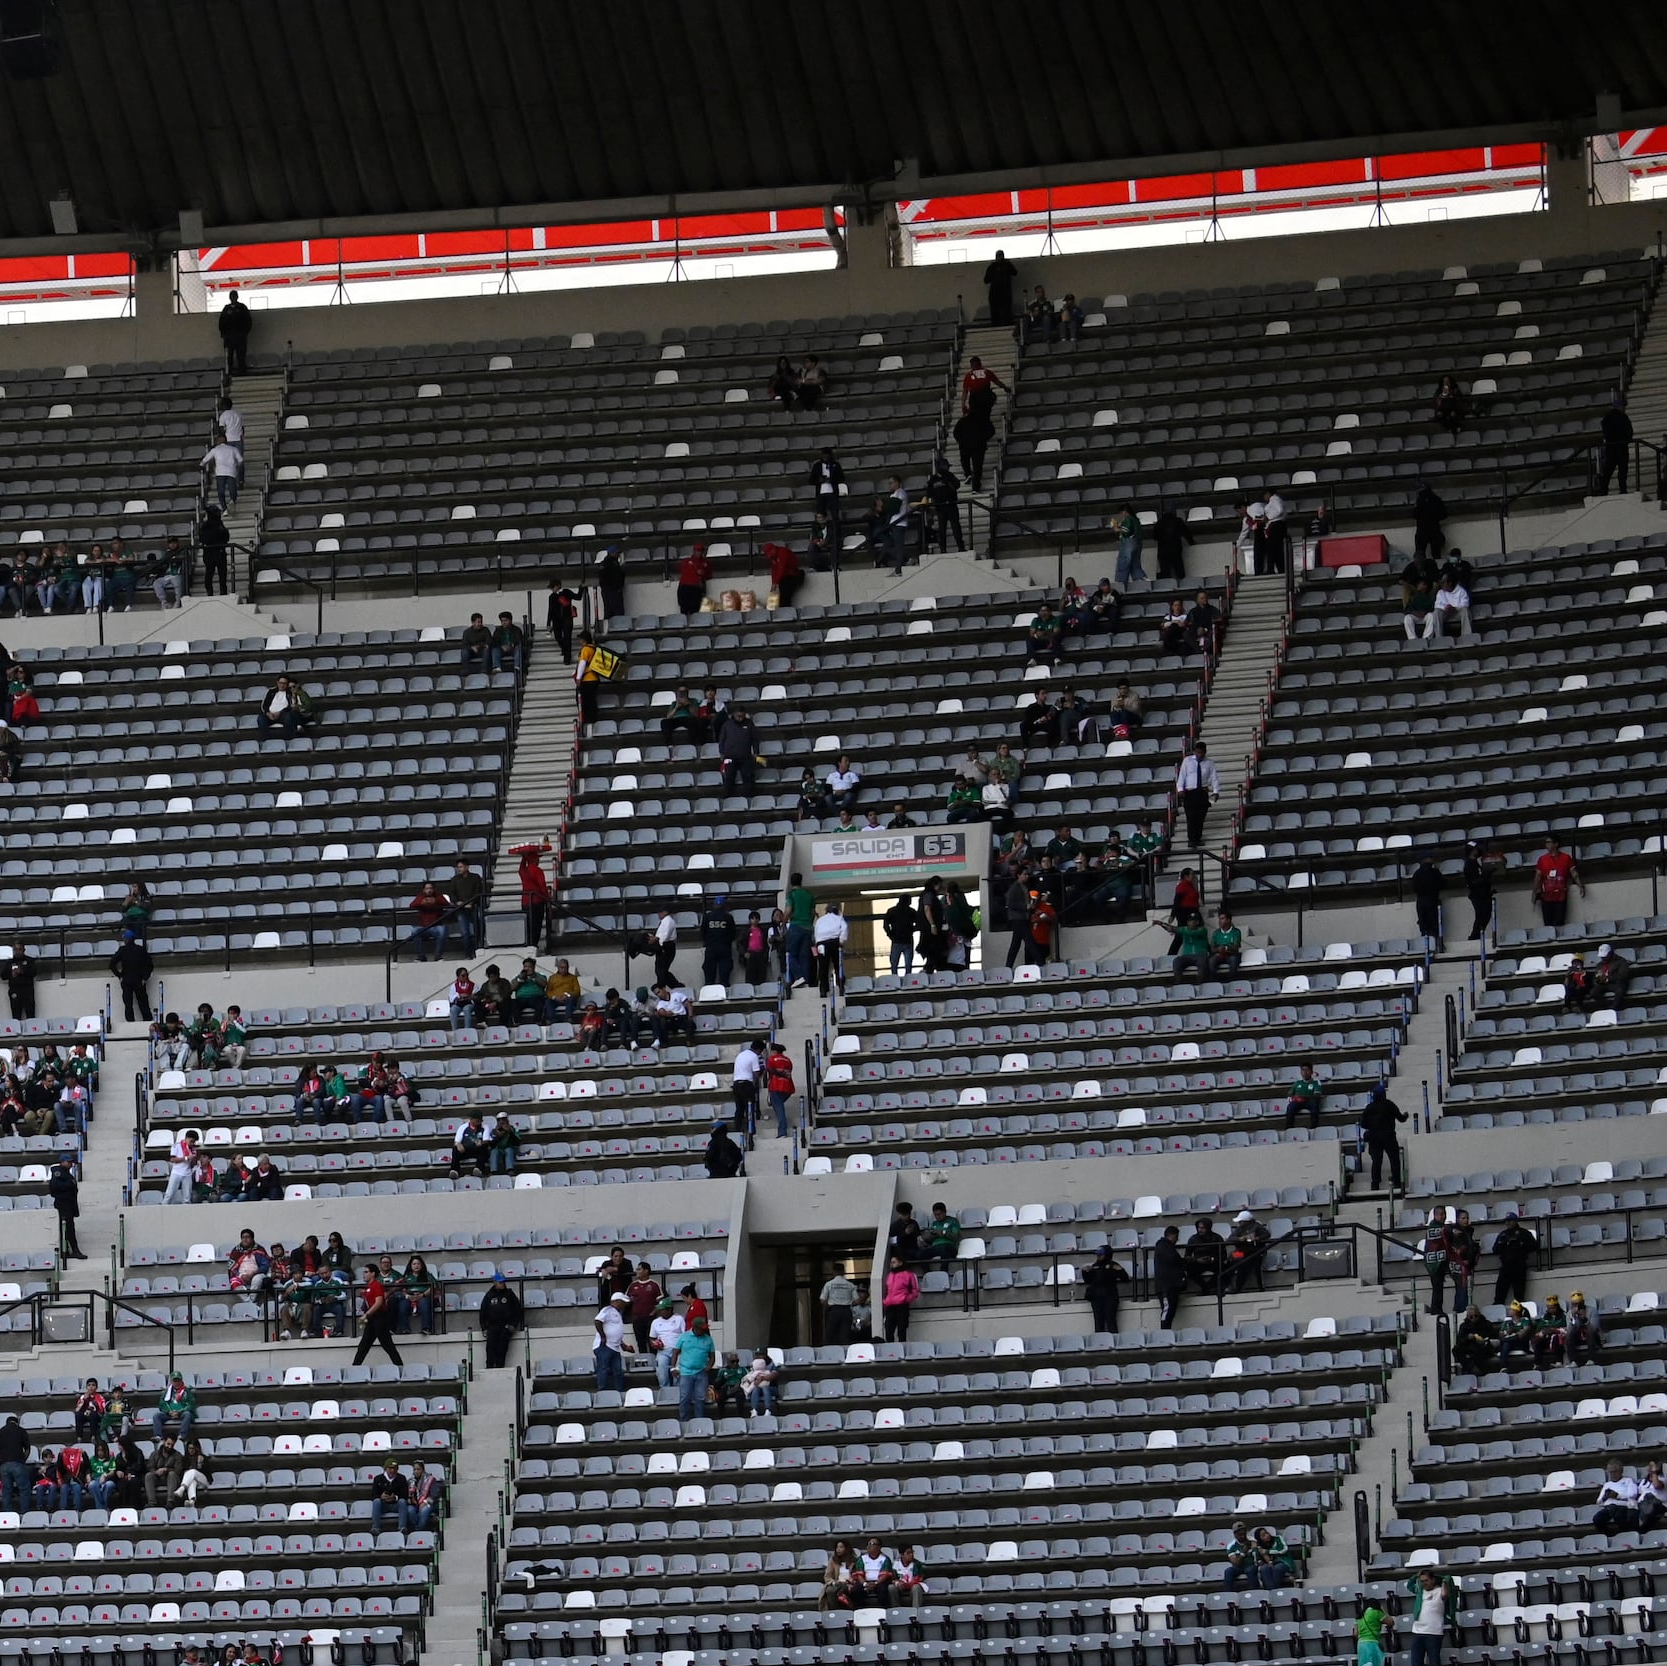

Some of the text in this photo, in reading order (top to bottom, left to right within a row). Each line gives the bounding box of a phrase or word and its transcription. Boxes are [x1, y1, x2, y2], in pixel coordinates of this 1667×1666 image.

[832, 835, 956, 856] SALIDA 63
[709, 920, 726, 929] SSC
